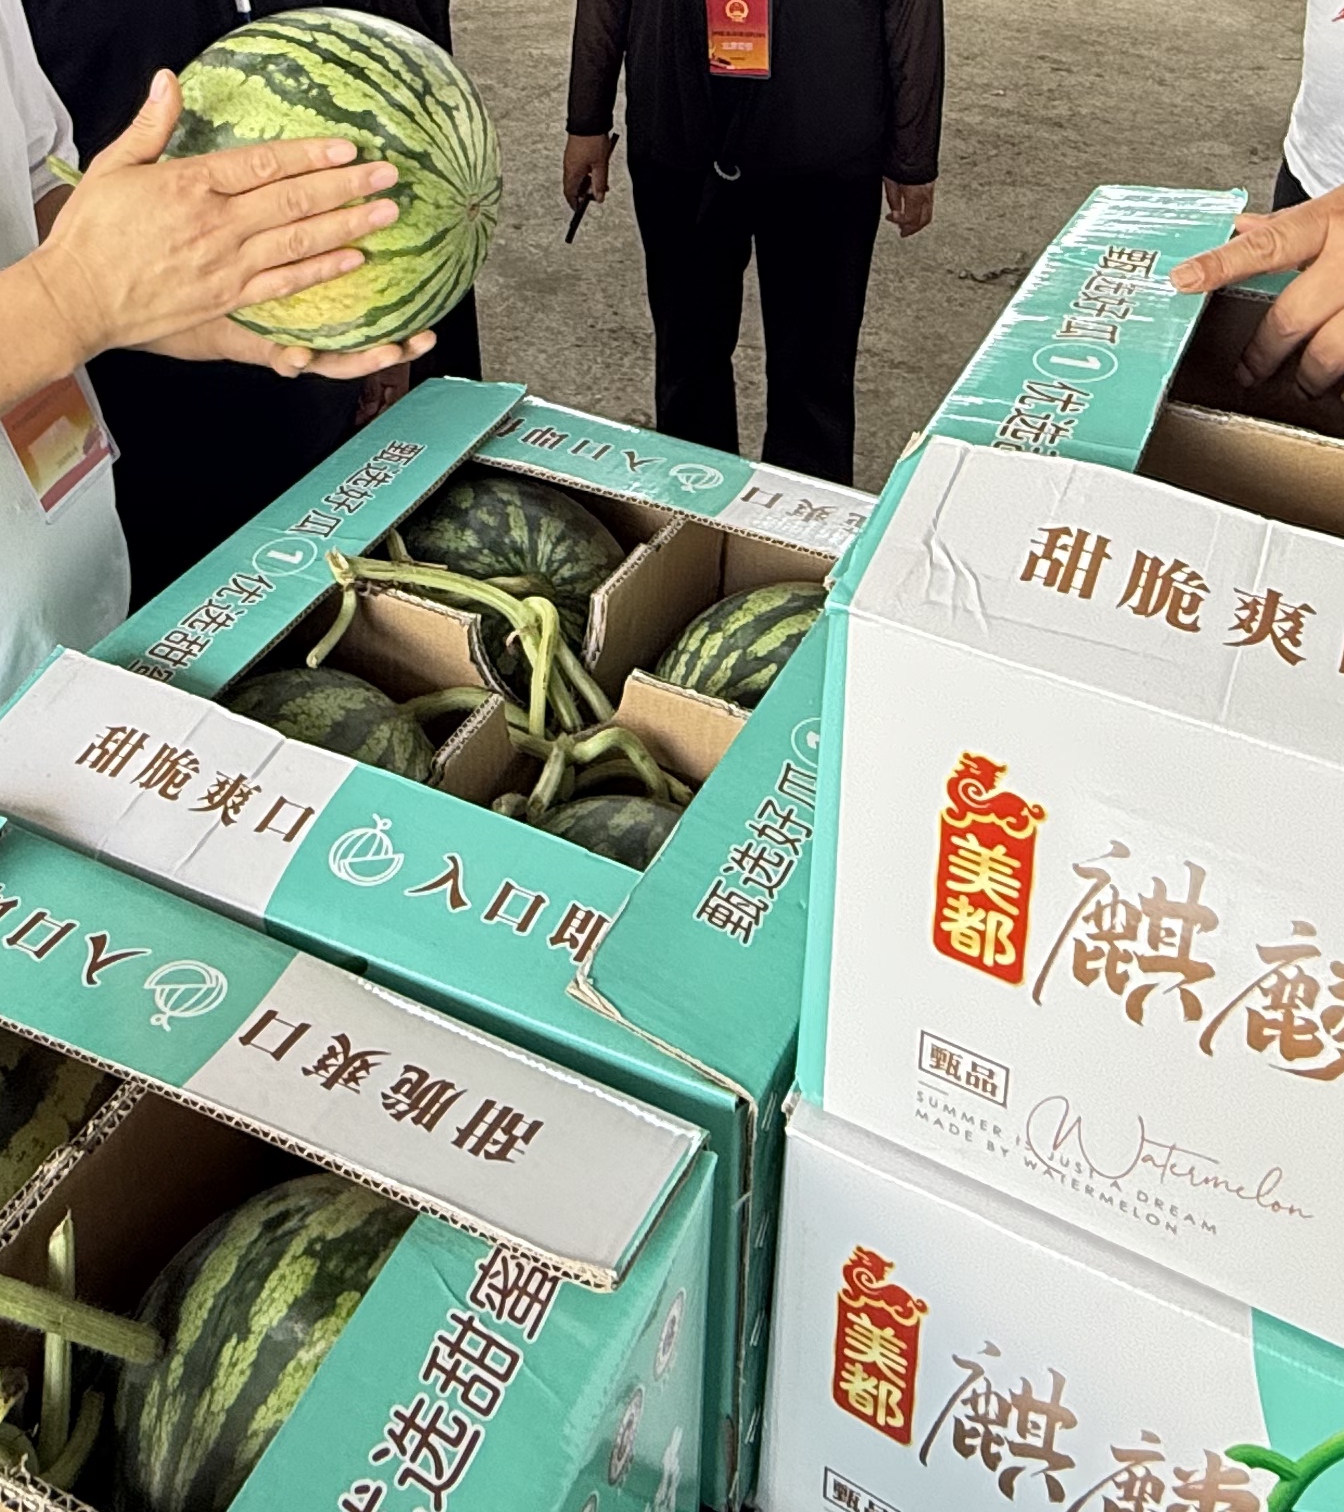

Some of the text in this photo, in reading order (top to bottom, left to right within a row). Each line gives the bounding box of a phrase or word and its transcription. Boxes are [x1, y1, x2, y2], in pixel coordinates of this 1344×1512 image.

[286, 439, 427, 539] 甄选好瓜
[74, 724, 319, 845] 甜脆爽口
[696, 762, 816, 945] 甄选好瓜
[940, 833, 1022, 967] 美都
[236, 1008, 545, 1164] 甜脆爽口
[930, 1044, 998, 1097] 甄品
[915, 1108, 1179, 1236] MADE BY WATERMELON
[916, 1090, 1003, 1138] SUMMER
[1047, 1151, 1096, 1180] JUST
[1136, 1190, 1218, 1236] DREAM
[1026, 1095, 1315, 1219] Watermelon
[839, 1312, 908, 1428] 美都
